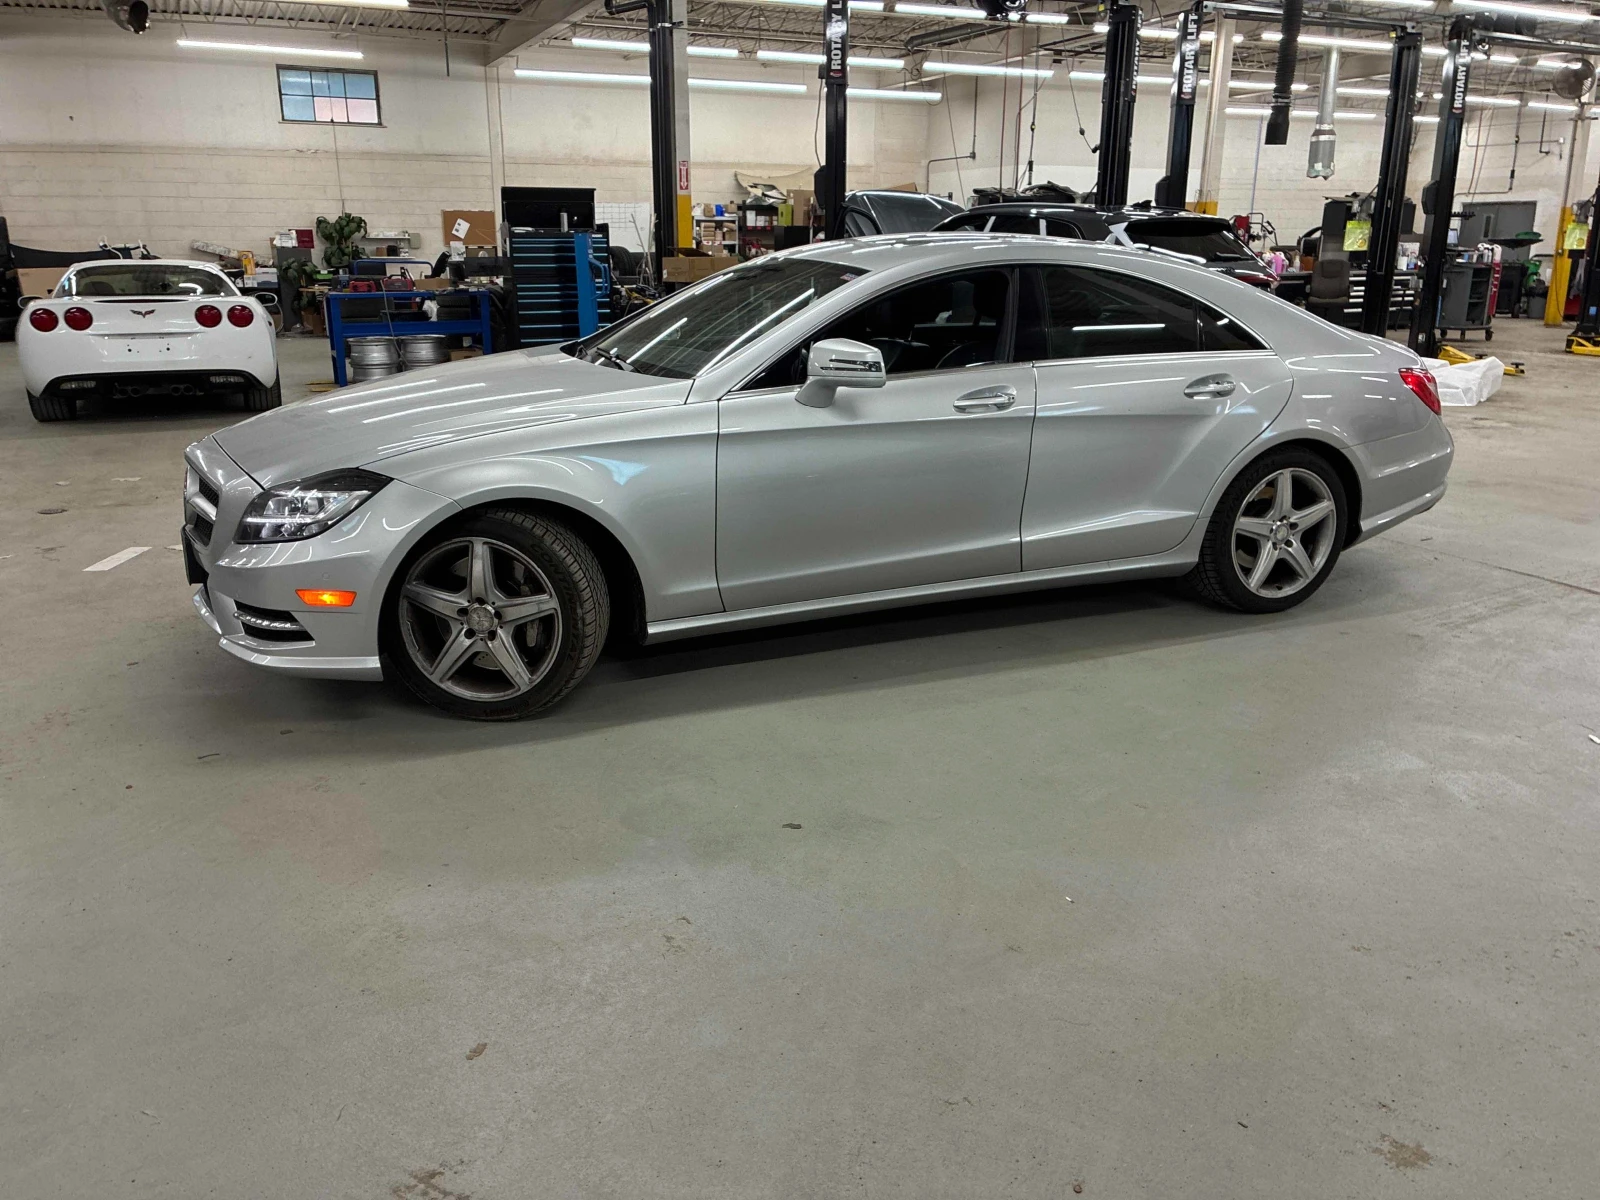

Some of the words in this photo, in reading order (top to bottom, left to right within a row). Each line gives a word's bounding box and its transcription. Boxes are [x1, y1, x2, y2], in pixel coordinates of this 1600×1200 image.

[831, 13, 842, 69] ROTARY
[1187, 13, 1198, 39] LIFT
[1182, 43, 1195, 92] ROTARY
[1459, 39, 1471, 63] LIFT
[1453, 65, 1466, 108] ROTARY
